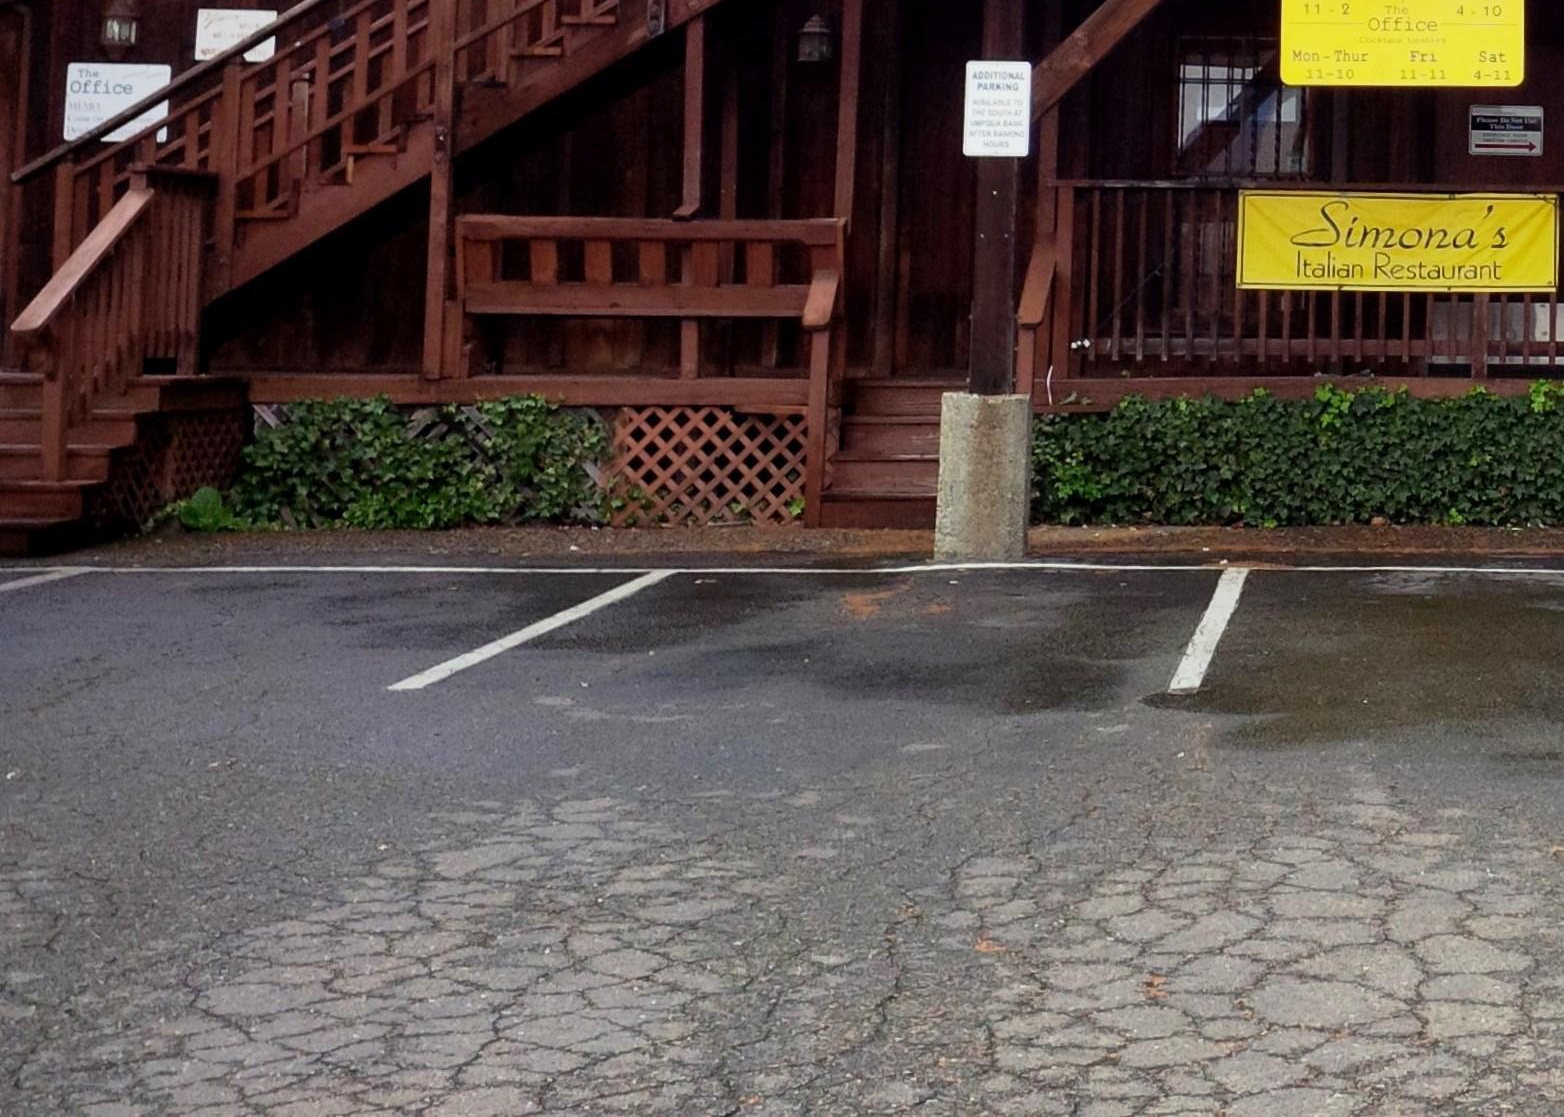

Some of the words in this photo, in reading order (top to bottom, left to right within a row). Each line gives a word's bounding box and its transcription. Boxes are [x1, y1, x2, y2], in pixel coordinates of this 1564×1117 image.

[1303, 3, 1321, 15] 11
[1341, 3, 1350, 15] 2
[1384, 5, 1409, 15] The
[1456, 5, 1465, 17] 4
[1484, 5, 1503, 17] 10
[1367, 16, 1438, 33] Office
[1409, 50, 1437, 63] Fri
[1478, 51, 1507, 63] Sat
[77, 68, 100, 79] The
[972, 71, 1025, 81] ADDITIONAL
[1305, 68, 1355, 80] 11-10
[1400, 69, 1447, 80] 11-11
[1473, 69, 1512, 81] 4-11
[70, 79, 134, 95] Office
[976, 82, 1020, 92] PARKING
[1290, 199, 1510, 249] Simona's
[1296, 250, 1364, 279] Italian
[1373, 251, 1503, 280] Restaurant
